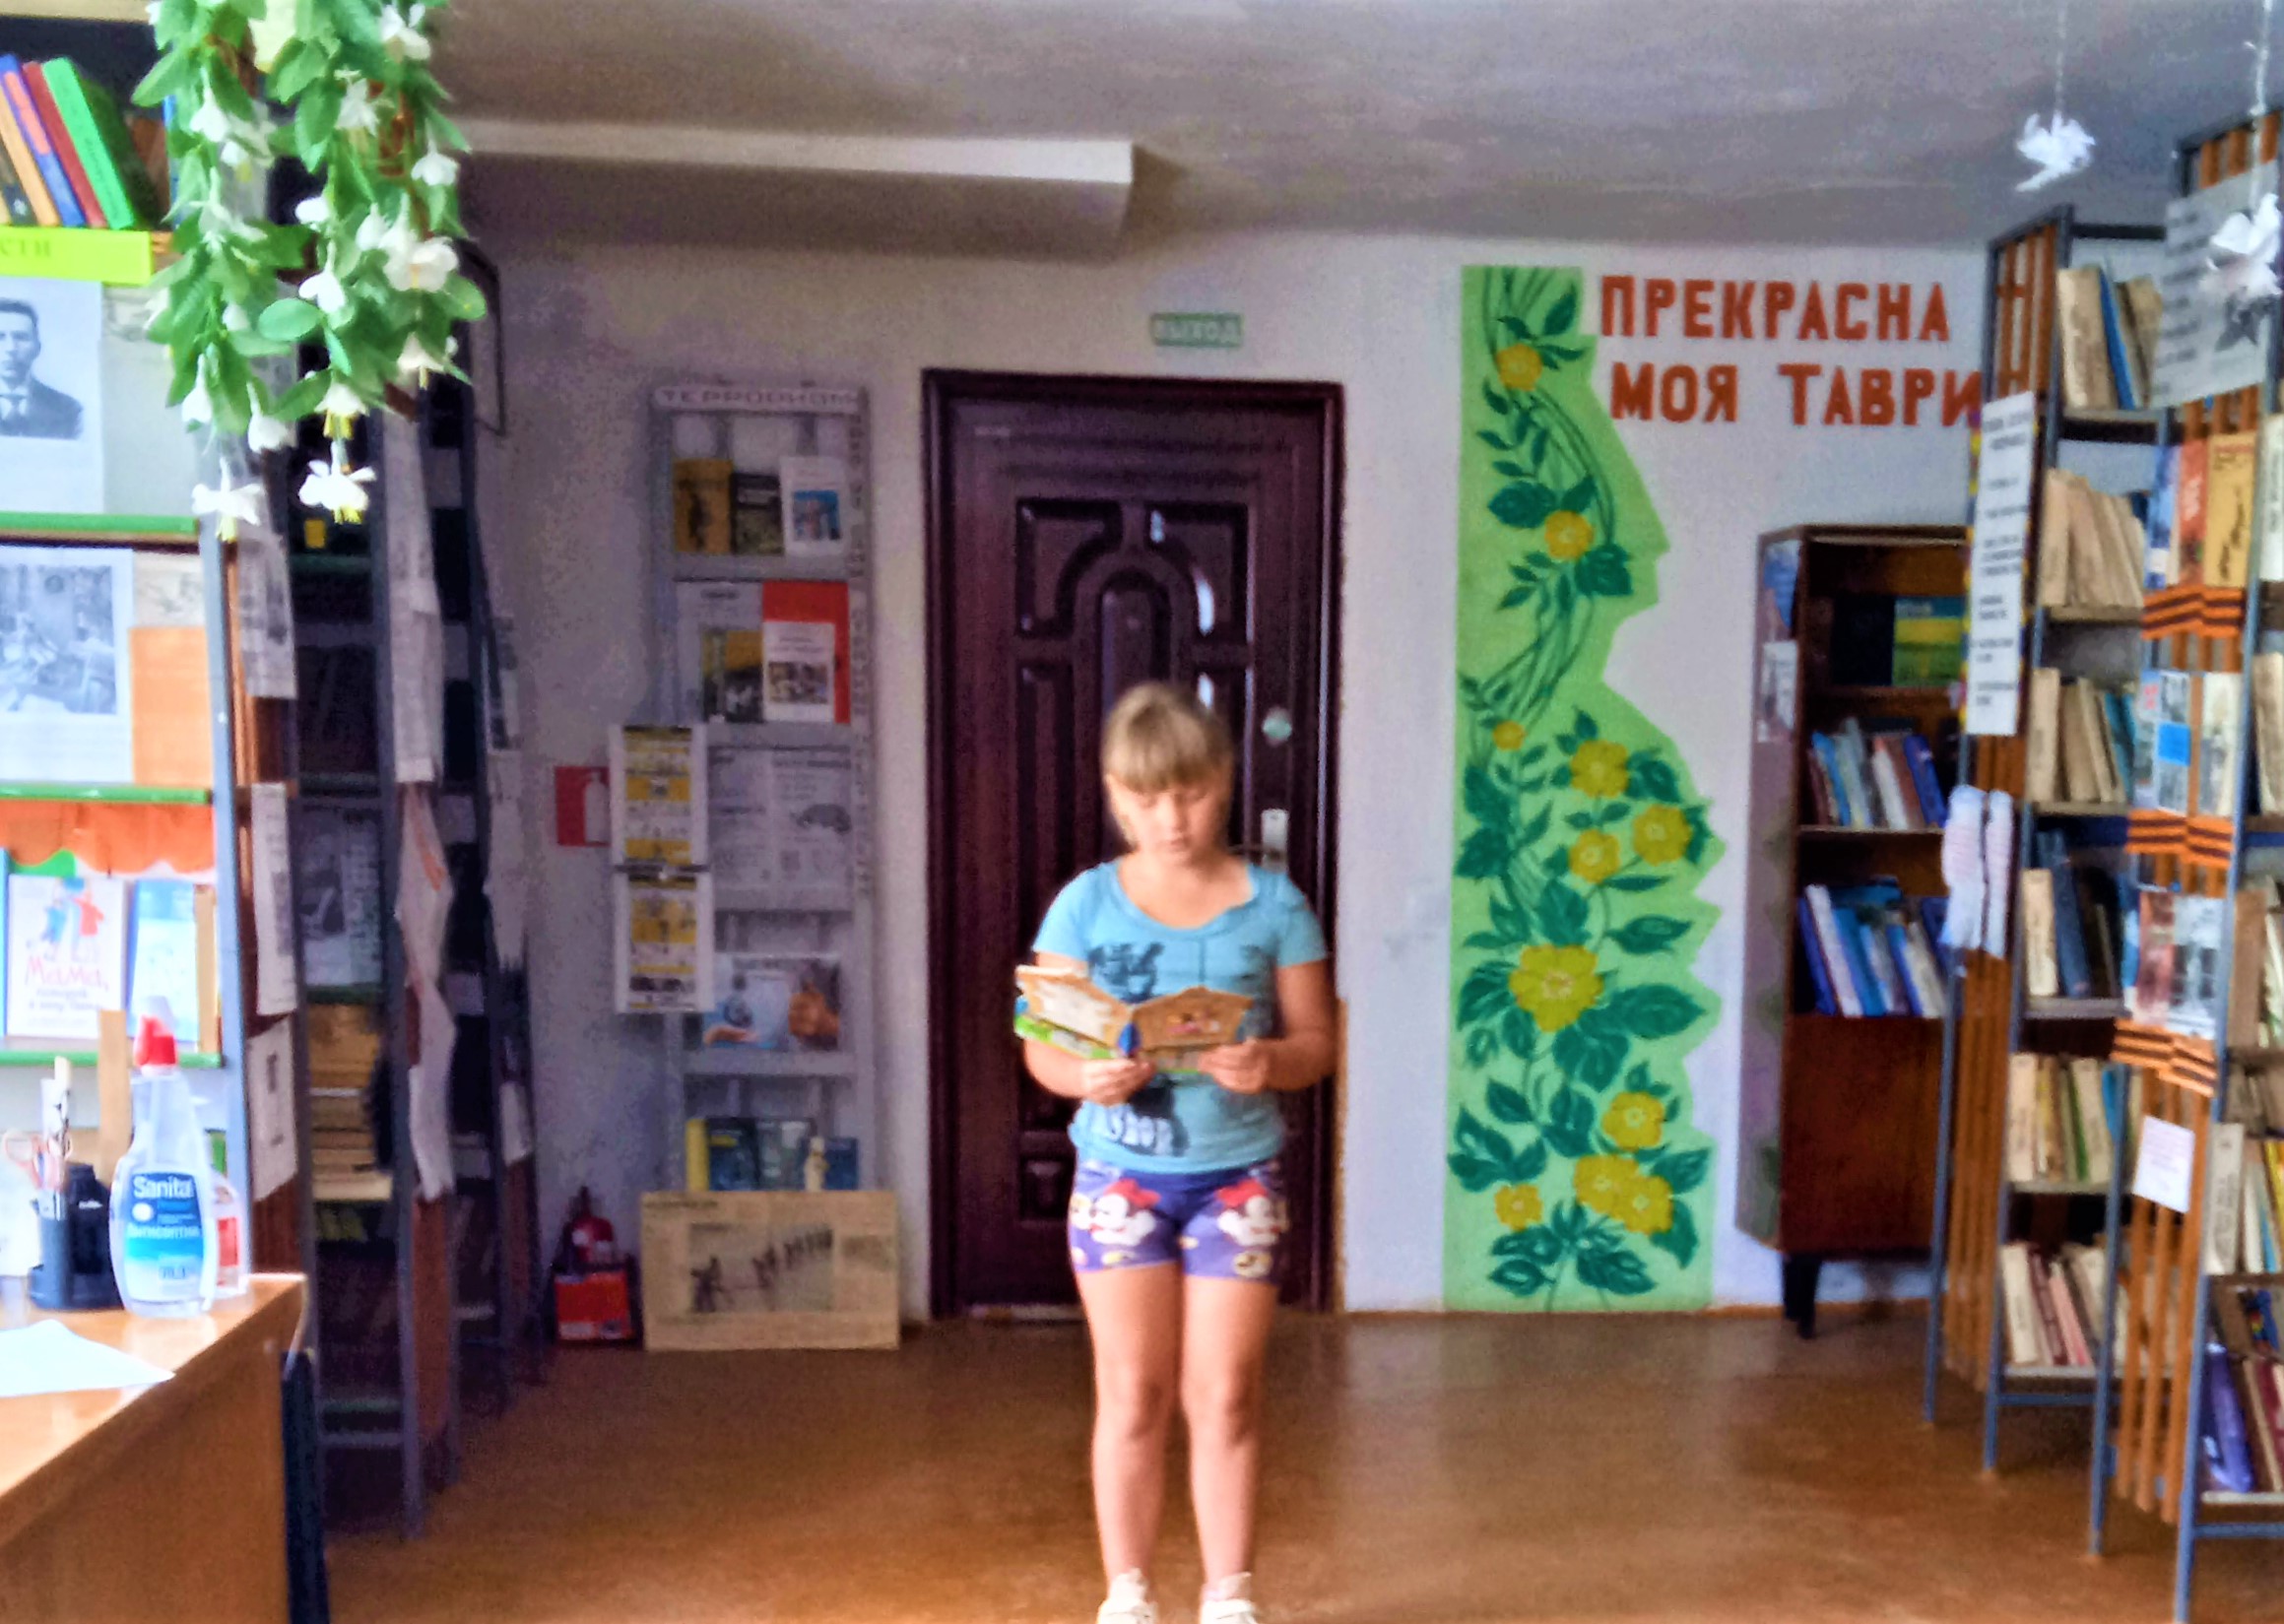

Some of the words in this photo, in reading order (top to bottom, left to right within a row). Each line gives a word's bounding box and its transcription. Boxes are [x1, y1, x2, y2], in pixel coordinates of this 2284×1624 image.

[1600, 275, 1950, 342] ПРЕКРАСНА
[1610, 361, 1738, 423] МОЯ
[1779, 362, 2027, 428] ТАВРИ
[132, 1175, 195, 1200] Sanita
